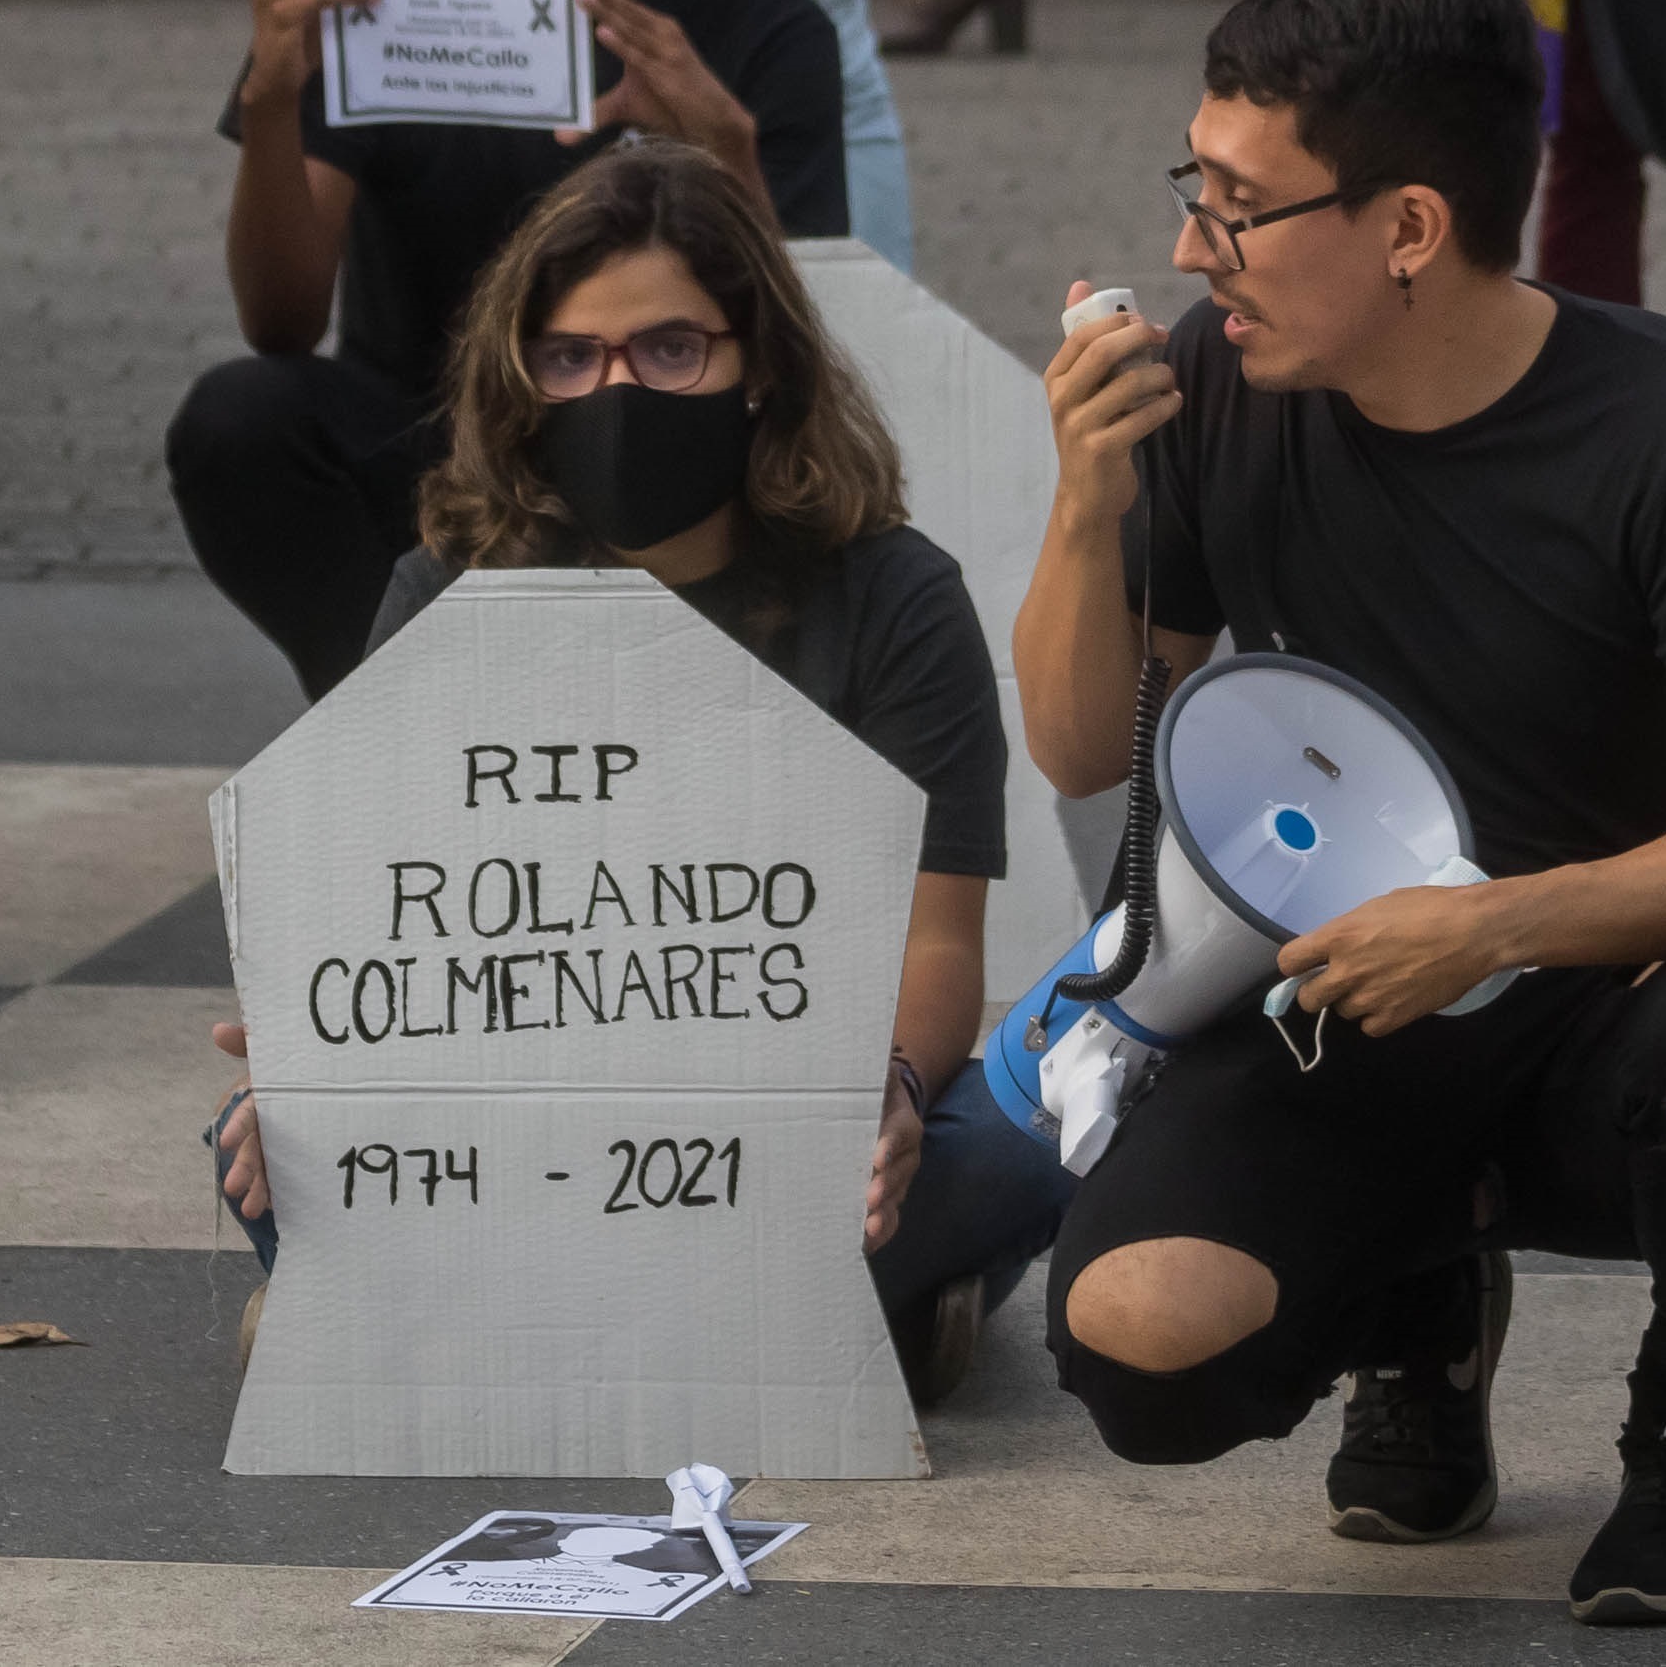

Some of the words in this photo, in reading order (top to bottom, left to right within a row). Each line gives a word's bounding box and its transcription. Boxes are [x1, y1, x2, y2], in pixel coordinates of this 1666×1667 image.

[463, 745, 638, 808] RIP
[387, 858, 816, 941] ROLANDO
[309, 943, 808, 1044] COLMENARES
[337, 1144, 477, 1209] 1974
[604, 1137, 740, 1214] 2021
[449, 1580, 630, 1596] #NoMeCallo
[491, 1596, 578, 1606] callaron
